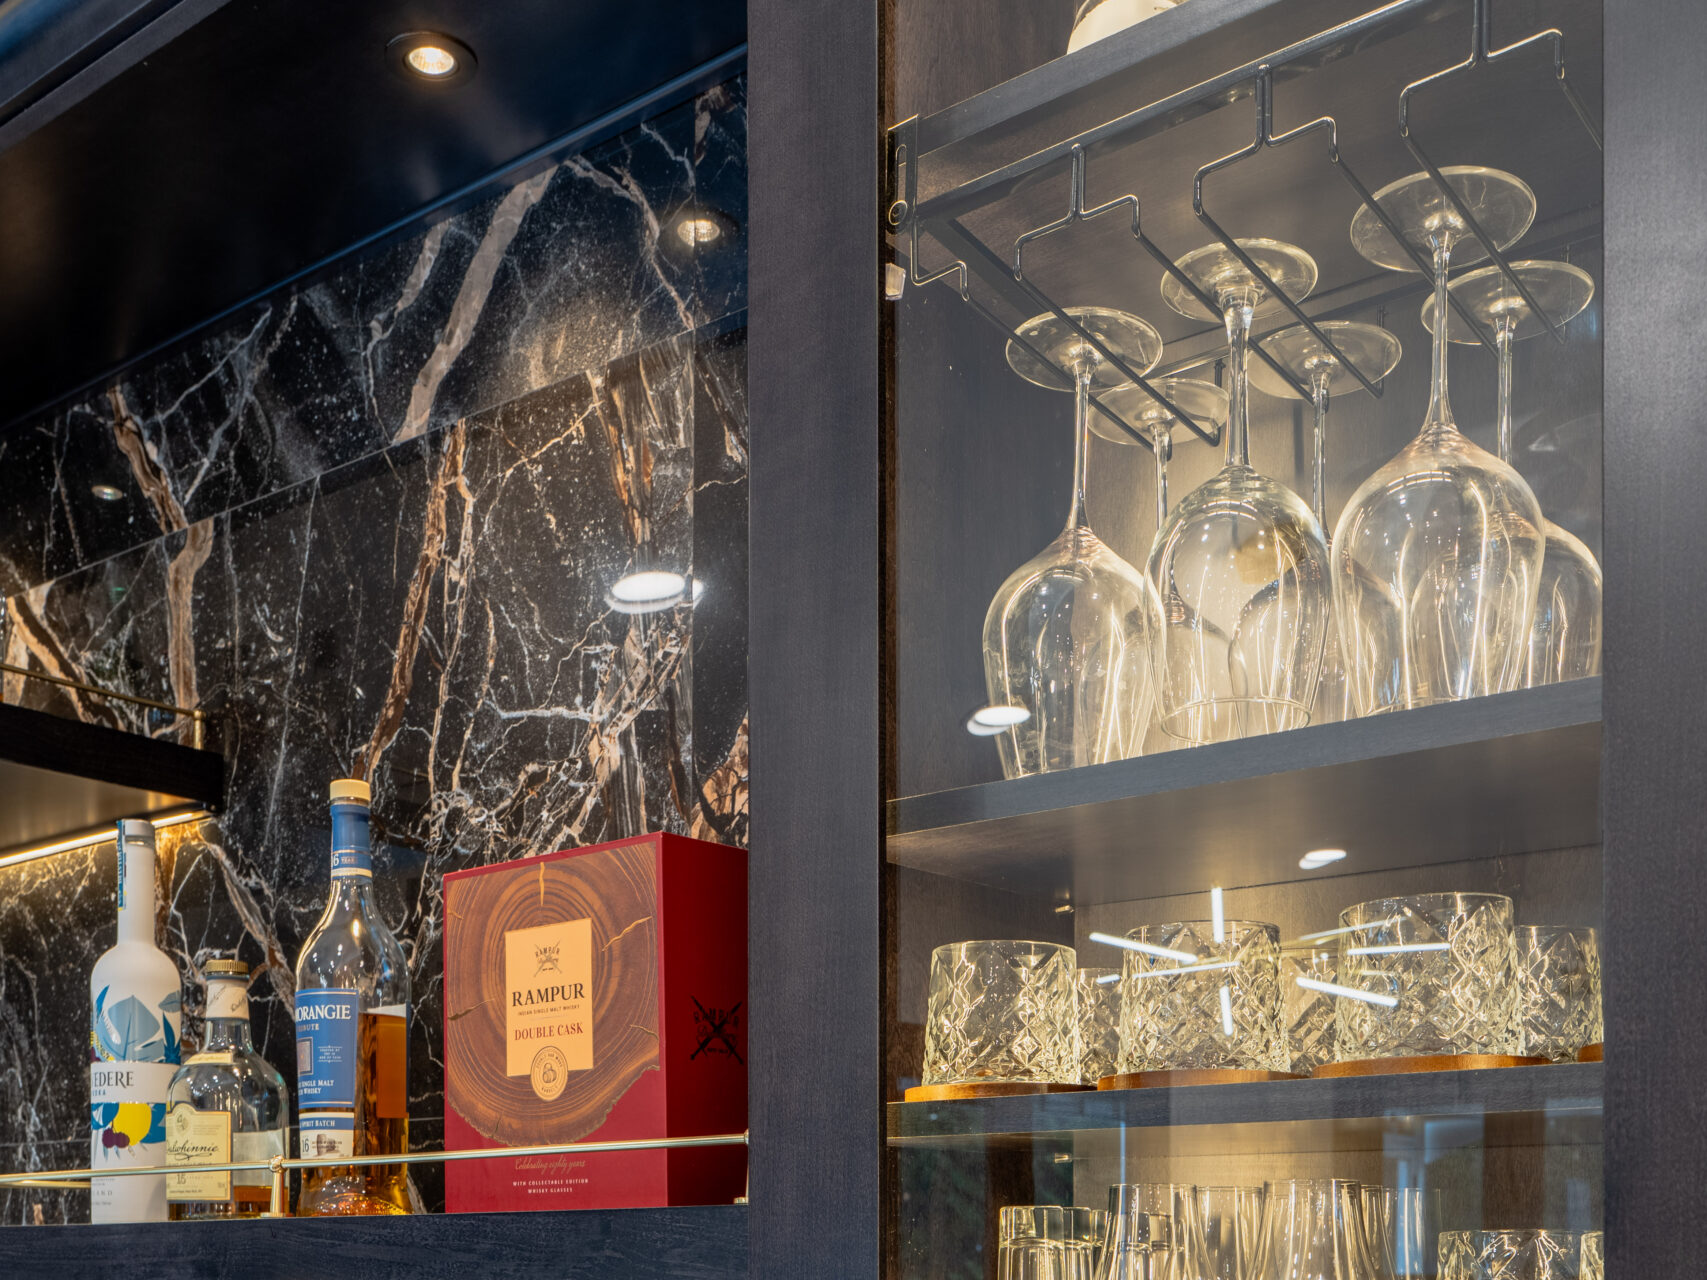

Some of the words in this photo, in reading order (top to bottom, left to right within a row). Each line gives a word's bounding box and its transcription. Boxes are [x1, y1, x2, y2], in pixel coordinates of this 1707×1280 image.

[512, 983, 585, 1007] RAMPUR
[515, 1025, 555, 1041] DOUBLE
[557, 1022, 584, 1036] CASK
[93, 1071, 135, 1089] EDERE
[302, 1138, 310, 1153] 16
[567, 1160, 586, 1174] years
